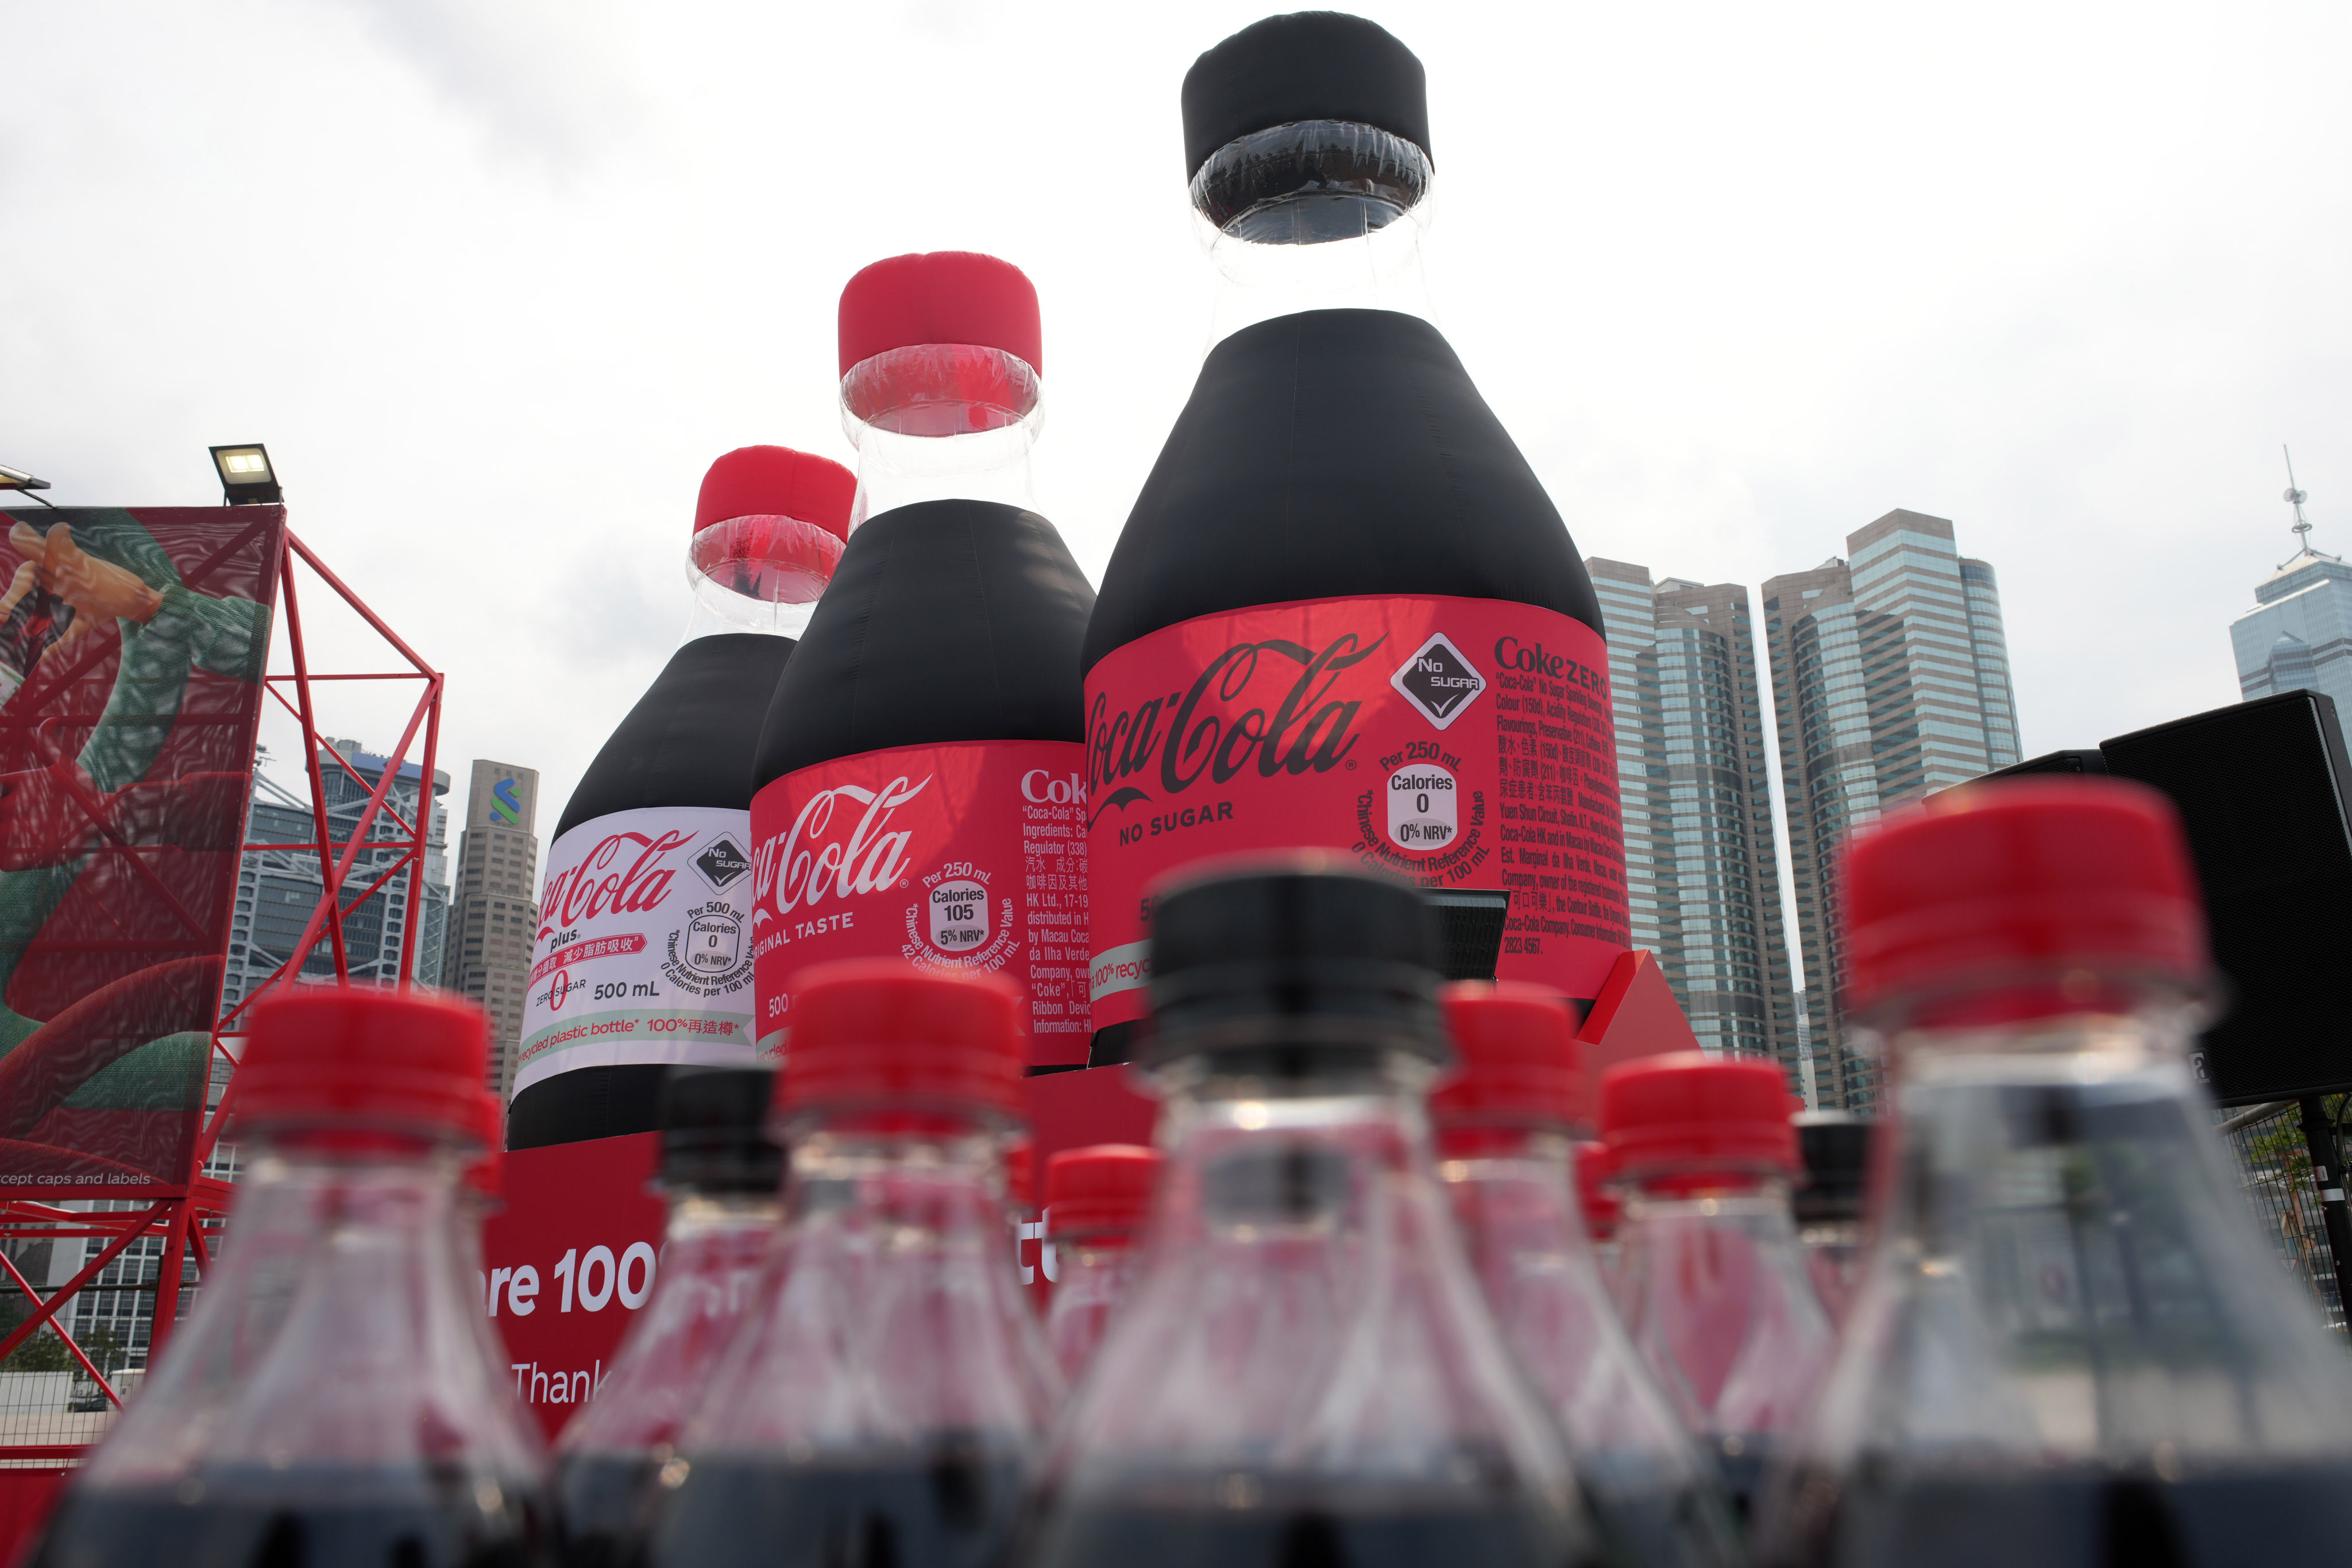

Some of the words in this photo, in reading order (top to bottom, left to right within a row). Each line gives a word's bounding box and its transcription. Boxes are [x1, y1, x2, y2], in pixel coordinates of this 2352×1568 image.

[1418, 658, 1443, 673] No
[1431, 677, 1479, 689] SUGAR
[1539, 678, 1547, 695] No
[1549, 680, 1565, 701] Sugar
[1087, 630, 1391, 798] Coca-Cola
[1497, 693, 1520, 712] Colour
[1547, 701, 1566, 723] Acidity
[1497, 715, 1538, 739] Flavourings,
[1539, 720, 1572, 742] Preservative
[1379, 750, 1404, 771] Per
[1405, 741, 1440, 759] 250
[1440, 750, 1462, 772] mL
[1391, 774, 1453, 790] Calories
[1416, 793, 1429, 813] 0
[1120, 823, 1142, 847] NO
[1150, 801, 1234, 836] SUGAR
[1500, 802, 1518, 820] Yuen
[1520, 803, 1536, 821] Shun
[1538, 805, 1559, 827] Circuit,
[1561, 809, 1579, 831] Shatin,
[1023, 823, 1073, 839] Ingredients:
[1374, 841, 1426, 872] Nutrient
[1427, 829, 1481, 871] Reference
[1470, 790, 1485, 826] Value
[1400, 823, 1420, 842] 0%
[1501, 824, 1536, 843] Coca-Cola
[1537, 827, 1547, 844] HK
[1548, 830, 1559, 846] and
[1560, 830, 1566, 847] in
[1566, 831, 1583, 850] Macau
[708, 848, 726, 858] No
[1024, 840, 1064, 856] Regulator
[716, 860, 751, 870] SUGAR
[1025, 856, 1046, 872] 汽水
[1351, 841, 1366, 853] 0
[1360, 851, 1416, 887] Calories
[1447, 861, 1473, 883] 100
[1471, 845, 1490, 867] mL
[1501, 846, 1515, 864] Est.
[1519, 847, 1548, 869] Marginal
[1552, 851, 1560, 868] da
[1563, 852, 1574, 870] Ilha
[922, 871, 942, 888] Per
[943, 862, 972, 878] 250
[974, 869, 992, 885] mL
[1026, 874, 1088, 891] 咖啡因及其他
[1502, 868, 1538, 890] Company,
[1540, 875, 1559, 890] owner
[1561, 874, 1567, 890] of
[1568, 875, 1577, 891] the
[1578, 877, 1601, 898] registered
[932, 889, 984, 903] Calories
[1026, 893, 1039, 907] HK
[1042, 893, 1061, 909] Ltd.,
[1064, 894, 1088, 908] 17-19
[1557, 896, 1566, 913] the
[1567, 896, 1587, 915] Contour
[687, 907, 704, 918] Per
[706, 902, 730, 914] 500
[729, 910, 744, 923] mL
[944, 904, 974, 921] 105
[1028, 911, 1072, 925] distributed
[1074, 912, 1082, 925] in
[693, 922, 736, 934] Calories
[920, 945, 962, 969] Nutrient
[963, 929, 1009, 968] Reference
[1000, 898, 1013, 928] Value
[1505, 914, 1539, 932] Coca-Cola
[1571, 918, 1596, 938] Consumer
[709, 935, 717, 948] 0
[753, 929, 790, 963] RIGINAL
[795, 912, 853, 939] TASTE
[941, 929, 957, 945] 5%
[1029, 929, 1038, 945] by
[1041, 929, 1068, 943] Macau
[1071, 929, 1089, 943] Coca
[1505, 936, 1523, 953] 2823
[1524, 937, 1543, 955] 4567.
[695, 953, 708, 965] 0%
[902, 944, 916, 959] 42
[983, 955, 1005, 974] 100
[1003, 940, 1020, 958] mL
[1029, 947, 1041, 961] da
[1045, 947, 1061, 960] Ilha
[1065, 947, 1090, 961] Verde
[661, 962, 670, 970] 0
[675, 963, 709, 985] Nutrient
[711, 960, 752, 985] Reference
[1030, 965, 1072, 982] Company,
[1095, 962, 1114, 988] 100%
[594, 982, 627, 1000] 500
[632, 981, 659, 997] mL
[665, 969, 701, 995] Calories
[723, 980, 743, 994] 100
[536, 990, 554, 1007] ZERO
[555, 979, 586, 997] SUGAR
[704, 987, 721, 998] per
[769, 993, 789, 1018] 500
[1033, 1001, 1063, 1015] Ribbon
[1034, 1019, 1082, 1033] Information:
[521, 1035, 549, 1063] recycled
[550, 1025, 588, 1049] plastic
[0, 1173, 33, 1187] cept
[37, 1175, 72, 1187] caps
[75, 1173, 103, 1184] and
[107, 1173, 150, 1184] labels
[479, 1264, 539, 1316] re
[554, 1241, 669, 1313] 100
